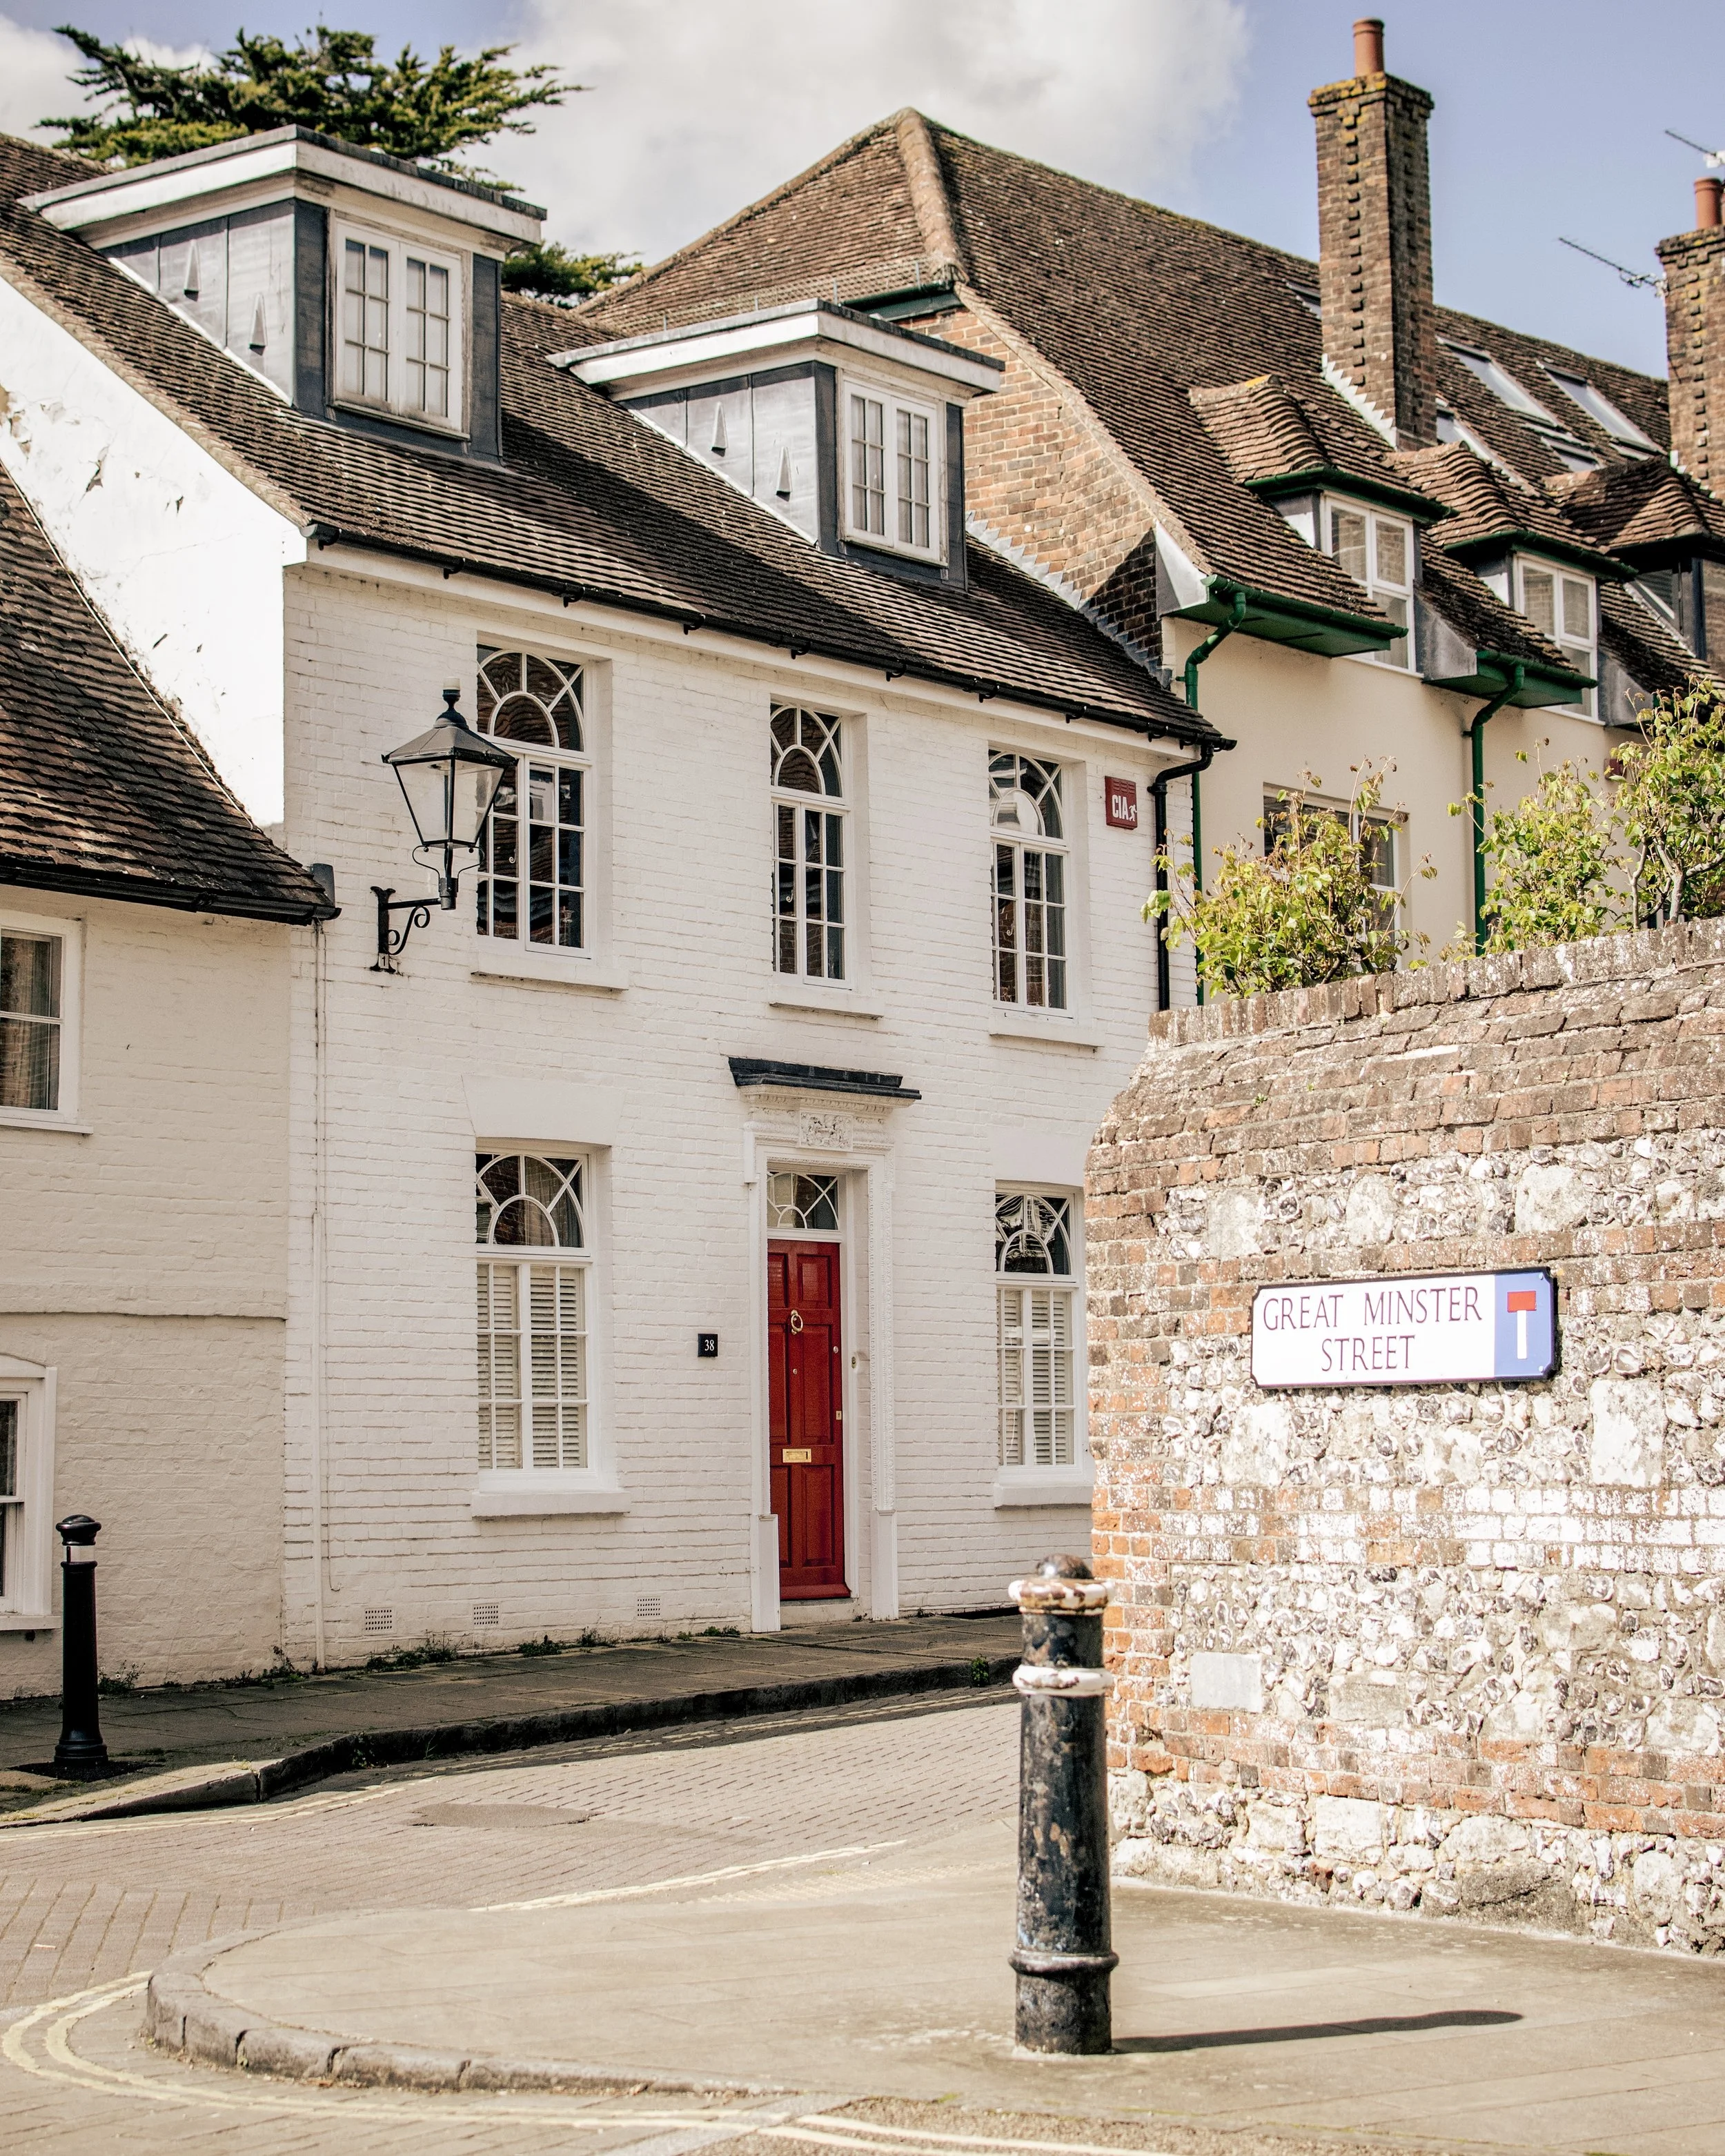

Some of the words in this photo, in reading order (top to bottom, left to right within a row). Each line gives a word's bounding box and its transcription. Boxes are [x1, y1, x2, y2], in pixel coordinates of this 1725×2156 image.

[1112, 794, 1129, 820] CIA
[382, 956, 386, 967] 1
[1263, 1294, 1344, 1331] GREAT
[1364, 1286, 1482, 1326] MINSTER
[704, 1339, 714, 1351] 38
[1321, 1334, 1415, 1372] STREET
